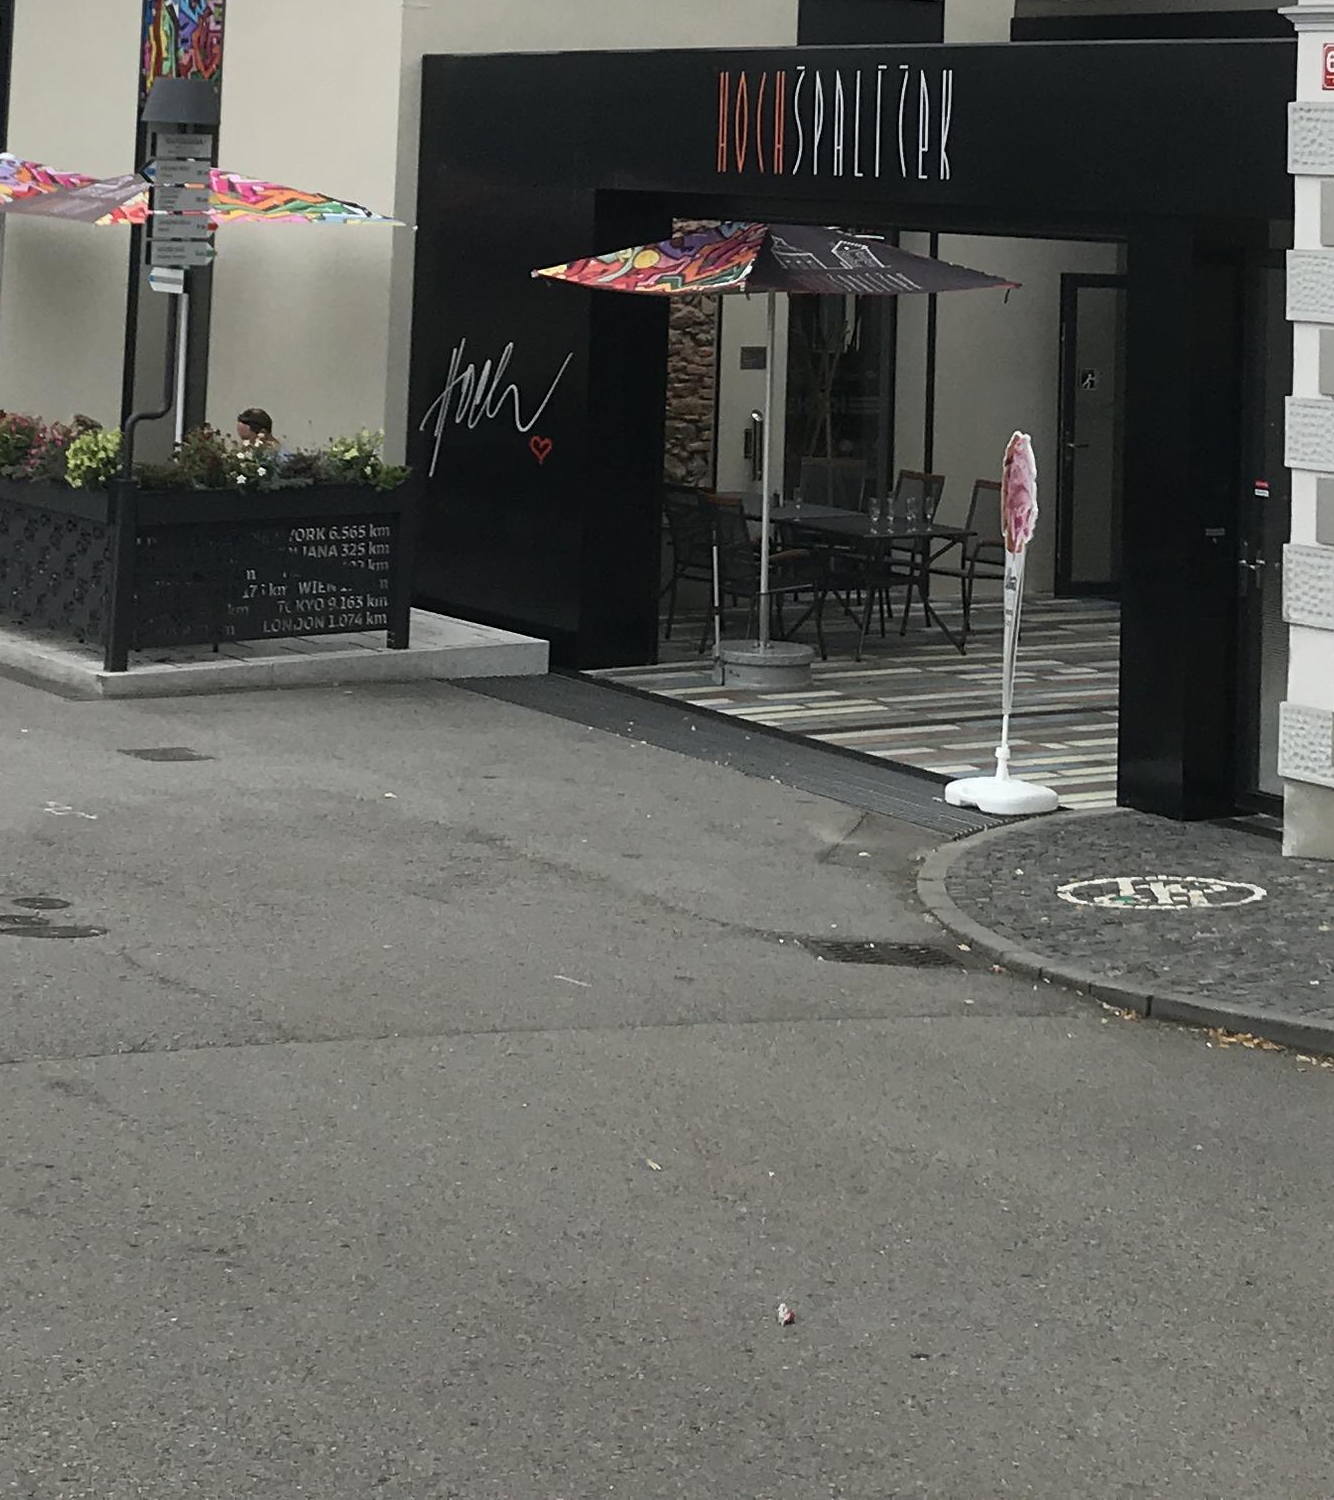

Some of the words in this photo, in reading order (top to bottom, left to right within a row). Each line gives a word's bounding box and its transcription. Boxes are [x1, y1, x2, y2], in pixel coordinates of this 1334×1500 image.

[329, 524, 367, 540] 6.565
[369, 523, 391, 537] km
[341, 542, 366, 557] 325
[368, 541, 390, 555] km
[367, 594, 388, 608] km
[366, 611, 388, 627] km
